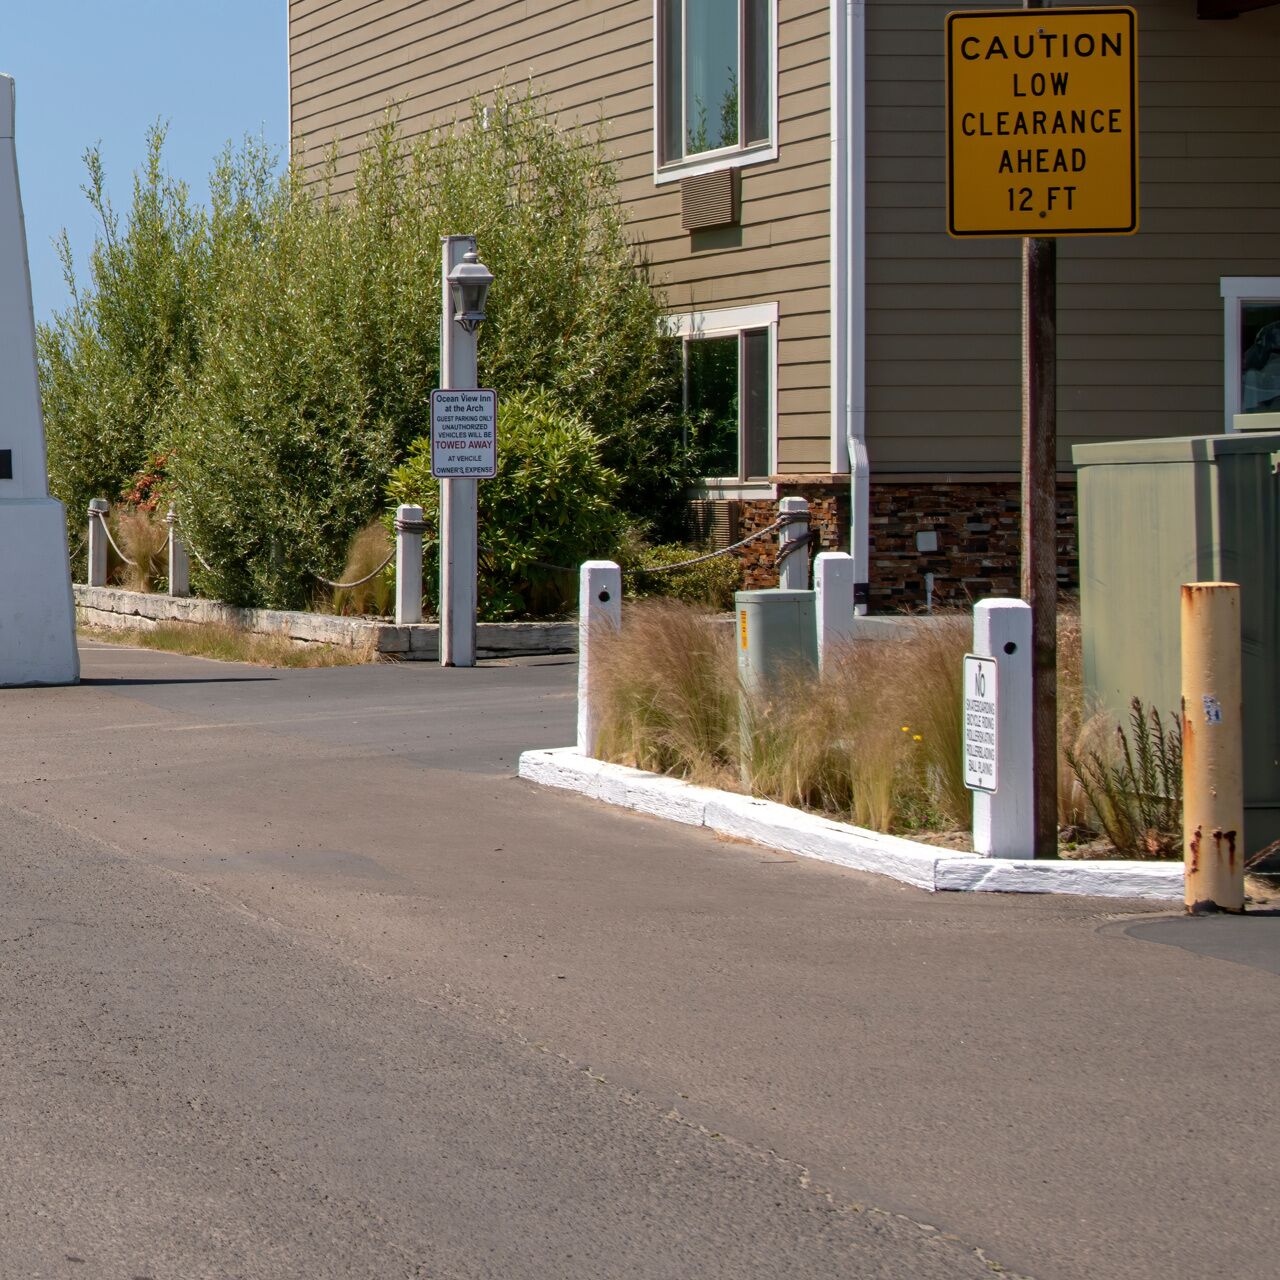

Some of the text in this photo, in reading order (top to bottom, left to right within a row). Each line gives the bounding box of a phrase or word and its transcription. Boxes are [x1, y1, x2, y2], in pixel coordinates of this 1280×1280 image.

[960, 32, 1122, 61] CAUTION
[1013, 72, 1069, 97] LOW
[961, 109, 1122, 136] CLEARANCE
[998, 148, 1086, 173] AHEAD
[1007, 186, 1076, 211] 12 FT
[436, 394, 492, 403] Ocean View Inn
[454, 404, 465, 412] the
[466, 404, 484, 412] Arch
[435, 440, 493, 449] TOWED AWAY
[438, 431, 467, 439] VEHICLES
[975, 672, 986, 698] NO
